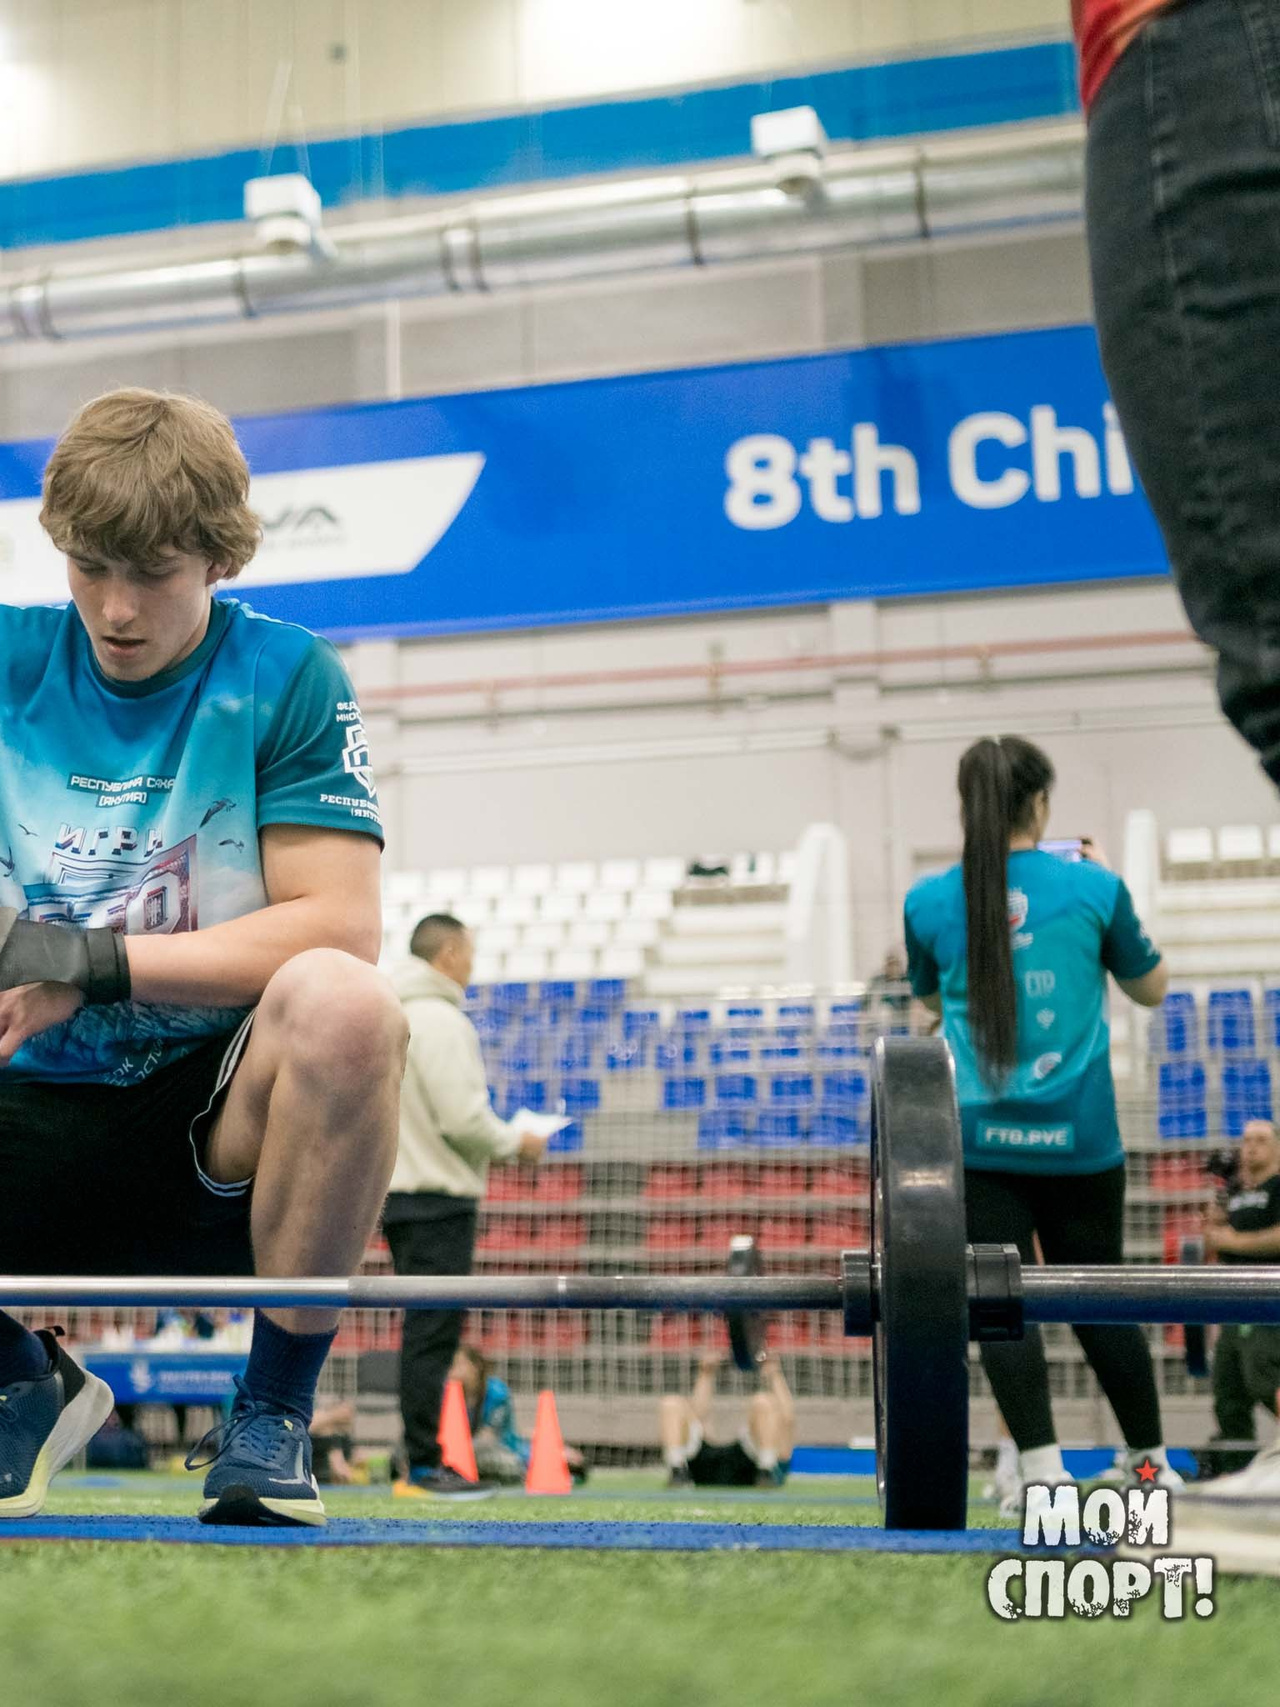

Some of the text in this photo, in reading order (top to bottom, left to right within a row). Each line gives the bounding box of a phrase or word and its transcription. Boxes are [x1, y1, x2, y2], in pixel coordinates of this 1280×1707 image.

[724, 403, 1137, 531] 8th Chi
[336, 711, 362, 722] МНО
[320, 793, 380, 814] РЕСПУБ
